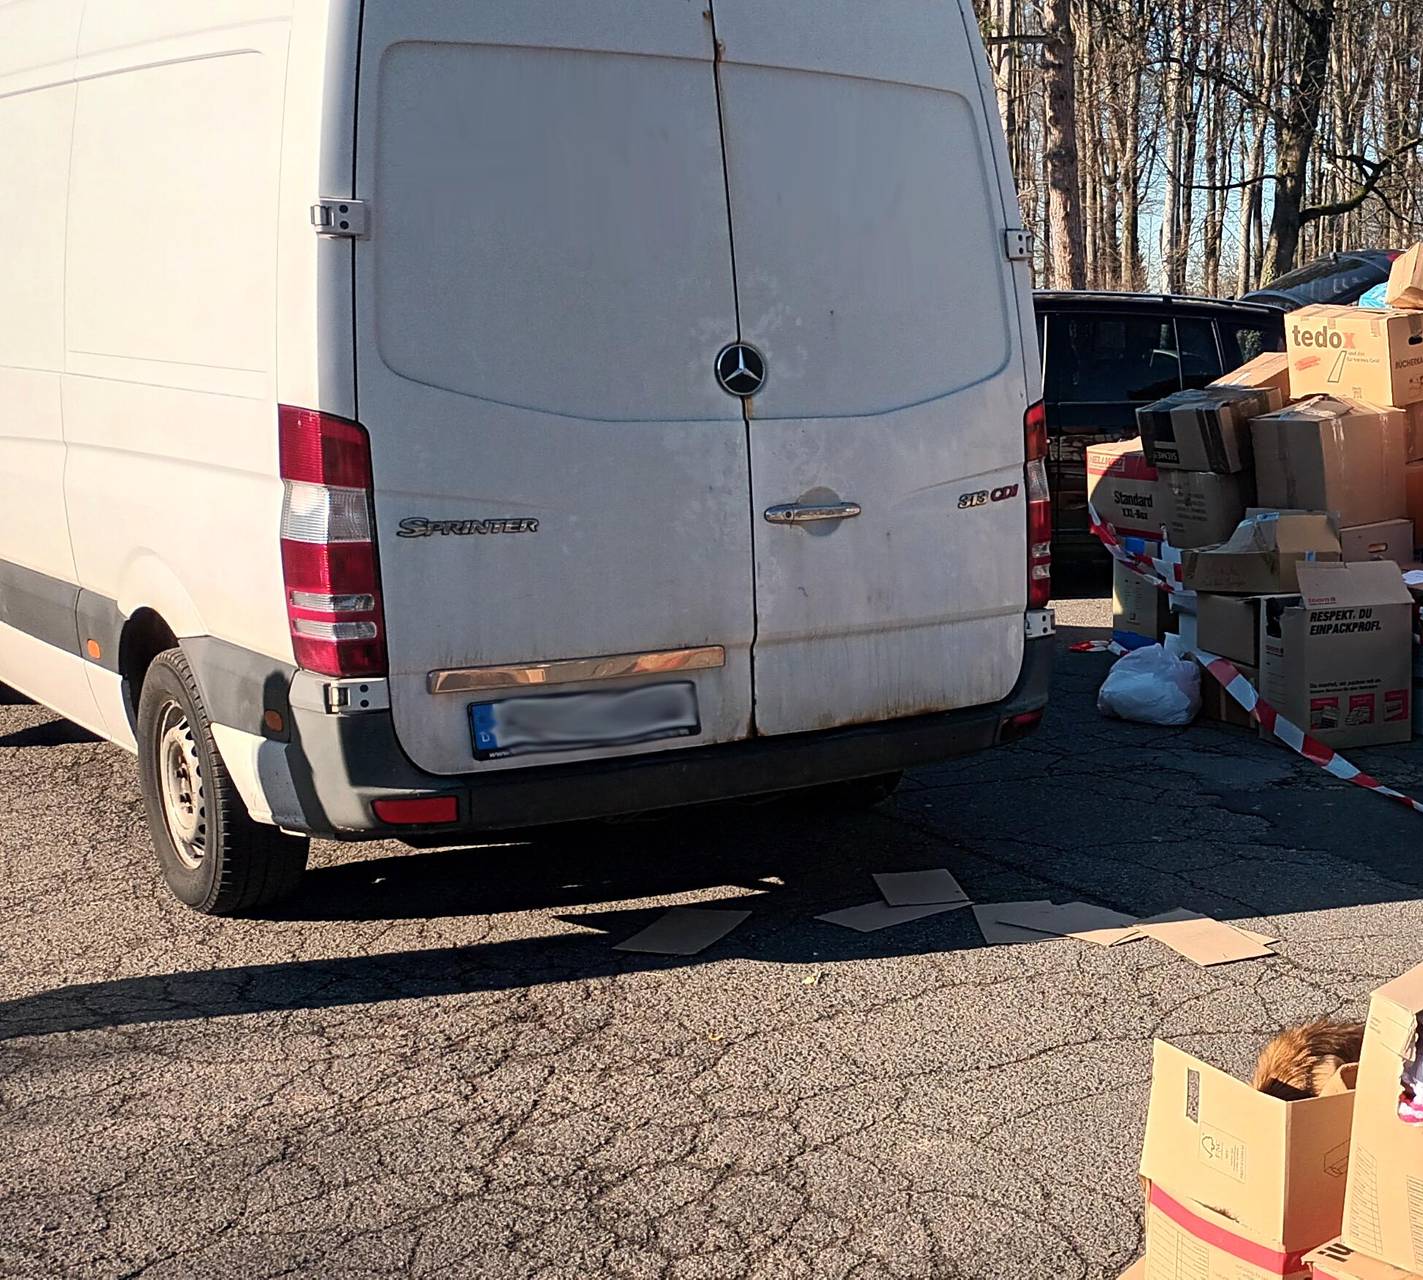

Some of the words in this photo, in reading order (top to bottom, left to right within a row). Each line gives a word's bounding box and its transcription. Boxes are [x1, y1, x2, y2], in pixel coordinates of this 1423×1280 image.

[1292, 324, 1356, 349] tedox
[990, 483, 1019, 502] CDI
[1113, 490, 1153, 508] Standard
[1358, 608, 1373, 620] DU
[1309, 620, 1382, 636] EINPACKPROFI.
